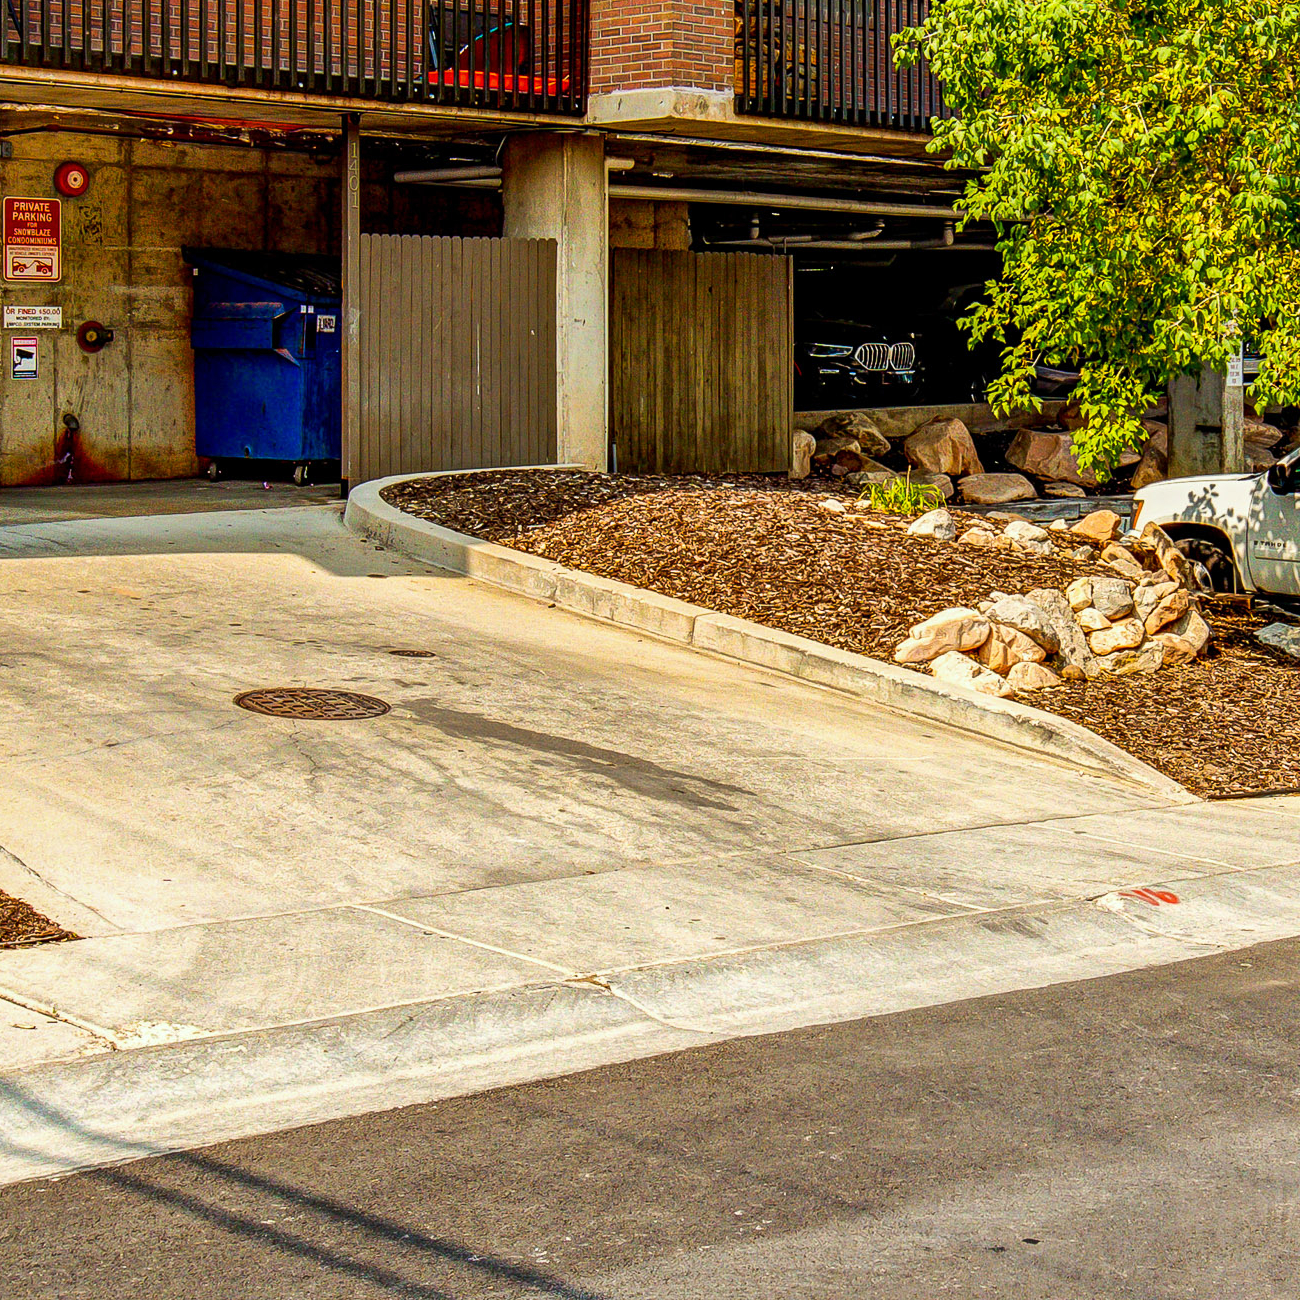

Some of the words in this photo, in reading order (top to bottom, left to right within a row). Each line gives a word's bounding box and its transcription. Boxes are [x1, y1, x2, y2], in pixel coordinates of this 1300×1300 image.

[13, 201, 50, 212] PRIVATE
[12, 211, 52, 222] PARKING
[13, 227, 51, 237] SNOWBLAZE
[7, 236, 57, 245] CONDOMINIUMS
